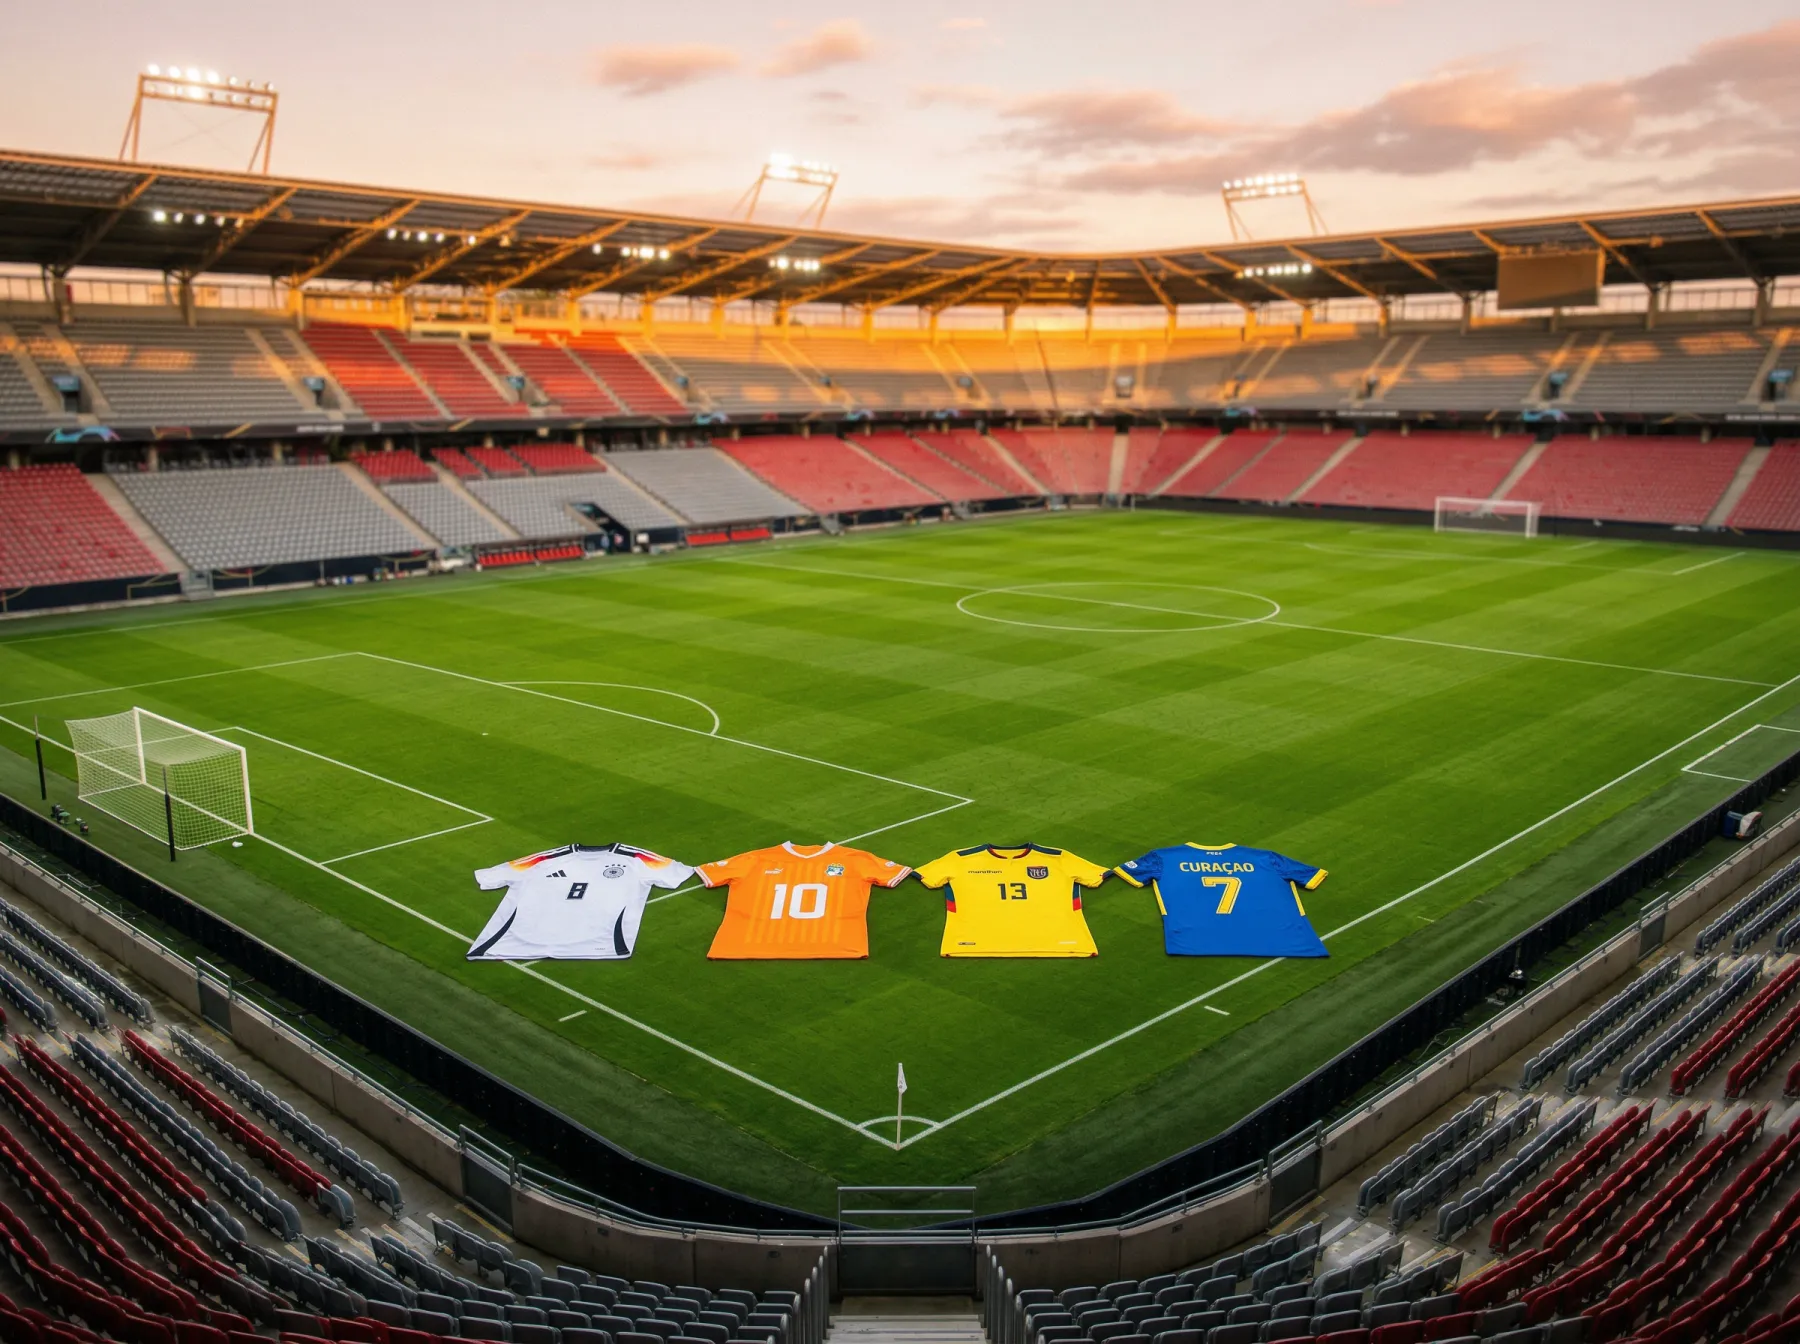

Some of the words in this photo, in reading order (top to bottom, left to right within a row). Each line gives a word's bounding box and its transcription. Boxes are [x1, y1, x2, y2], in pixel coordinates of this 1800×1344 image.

[1179, 862, 1255, 875] CURAÇAO
[566, 882, 588, 900] 8
[997, 882, 1027, 900] 13
[1201, 876, 1242, 914] 7
[770, 883, 828, 920] 10
